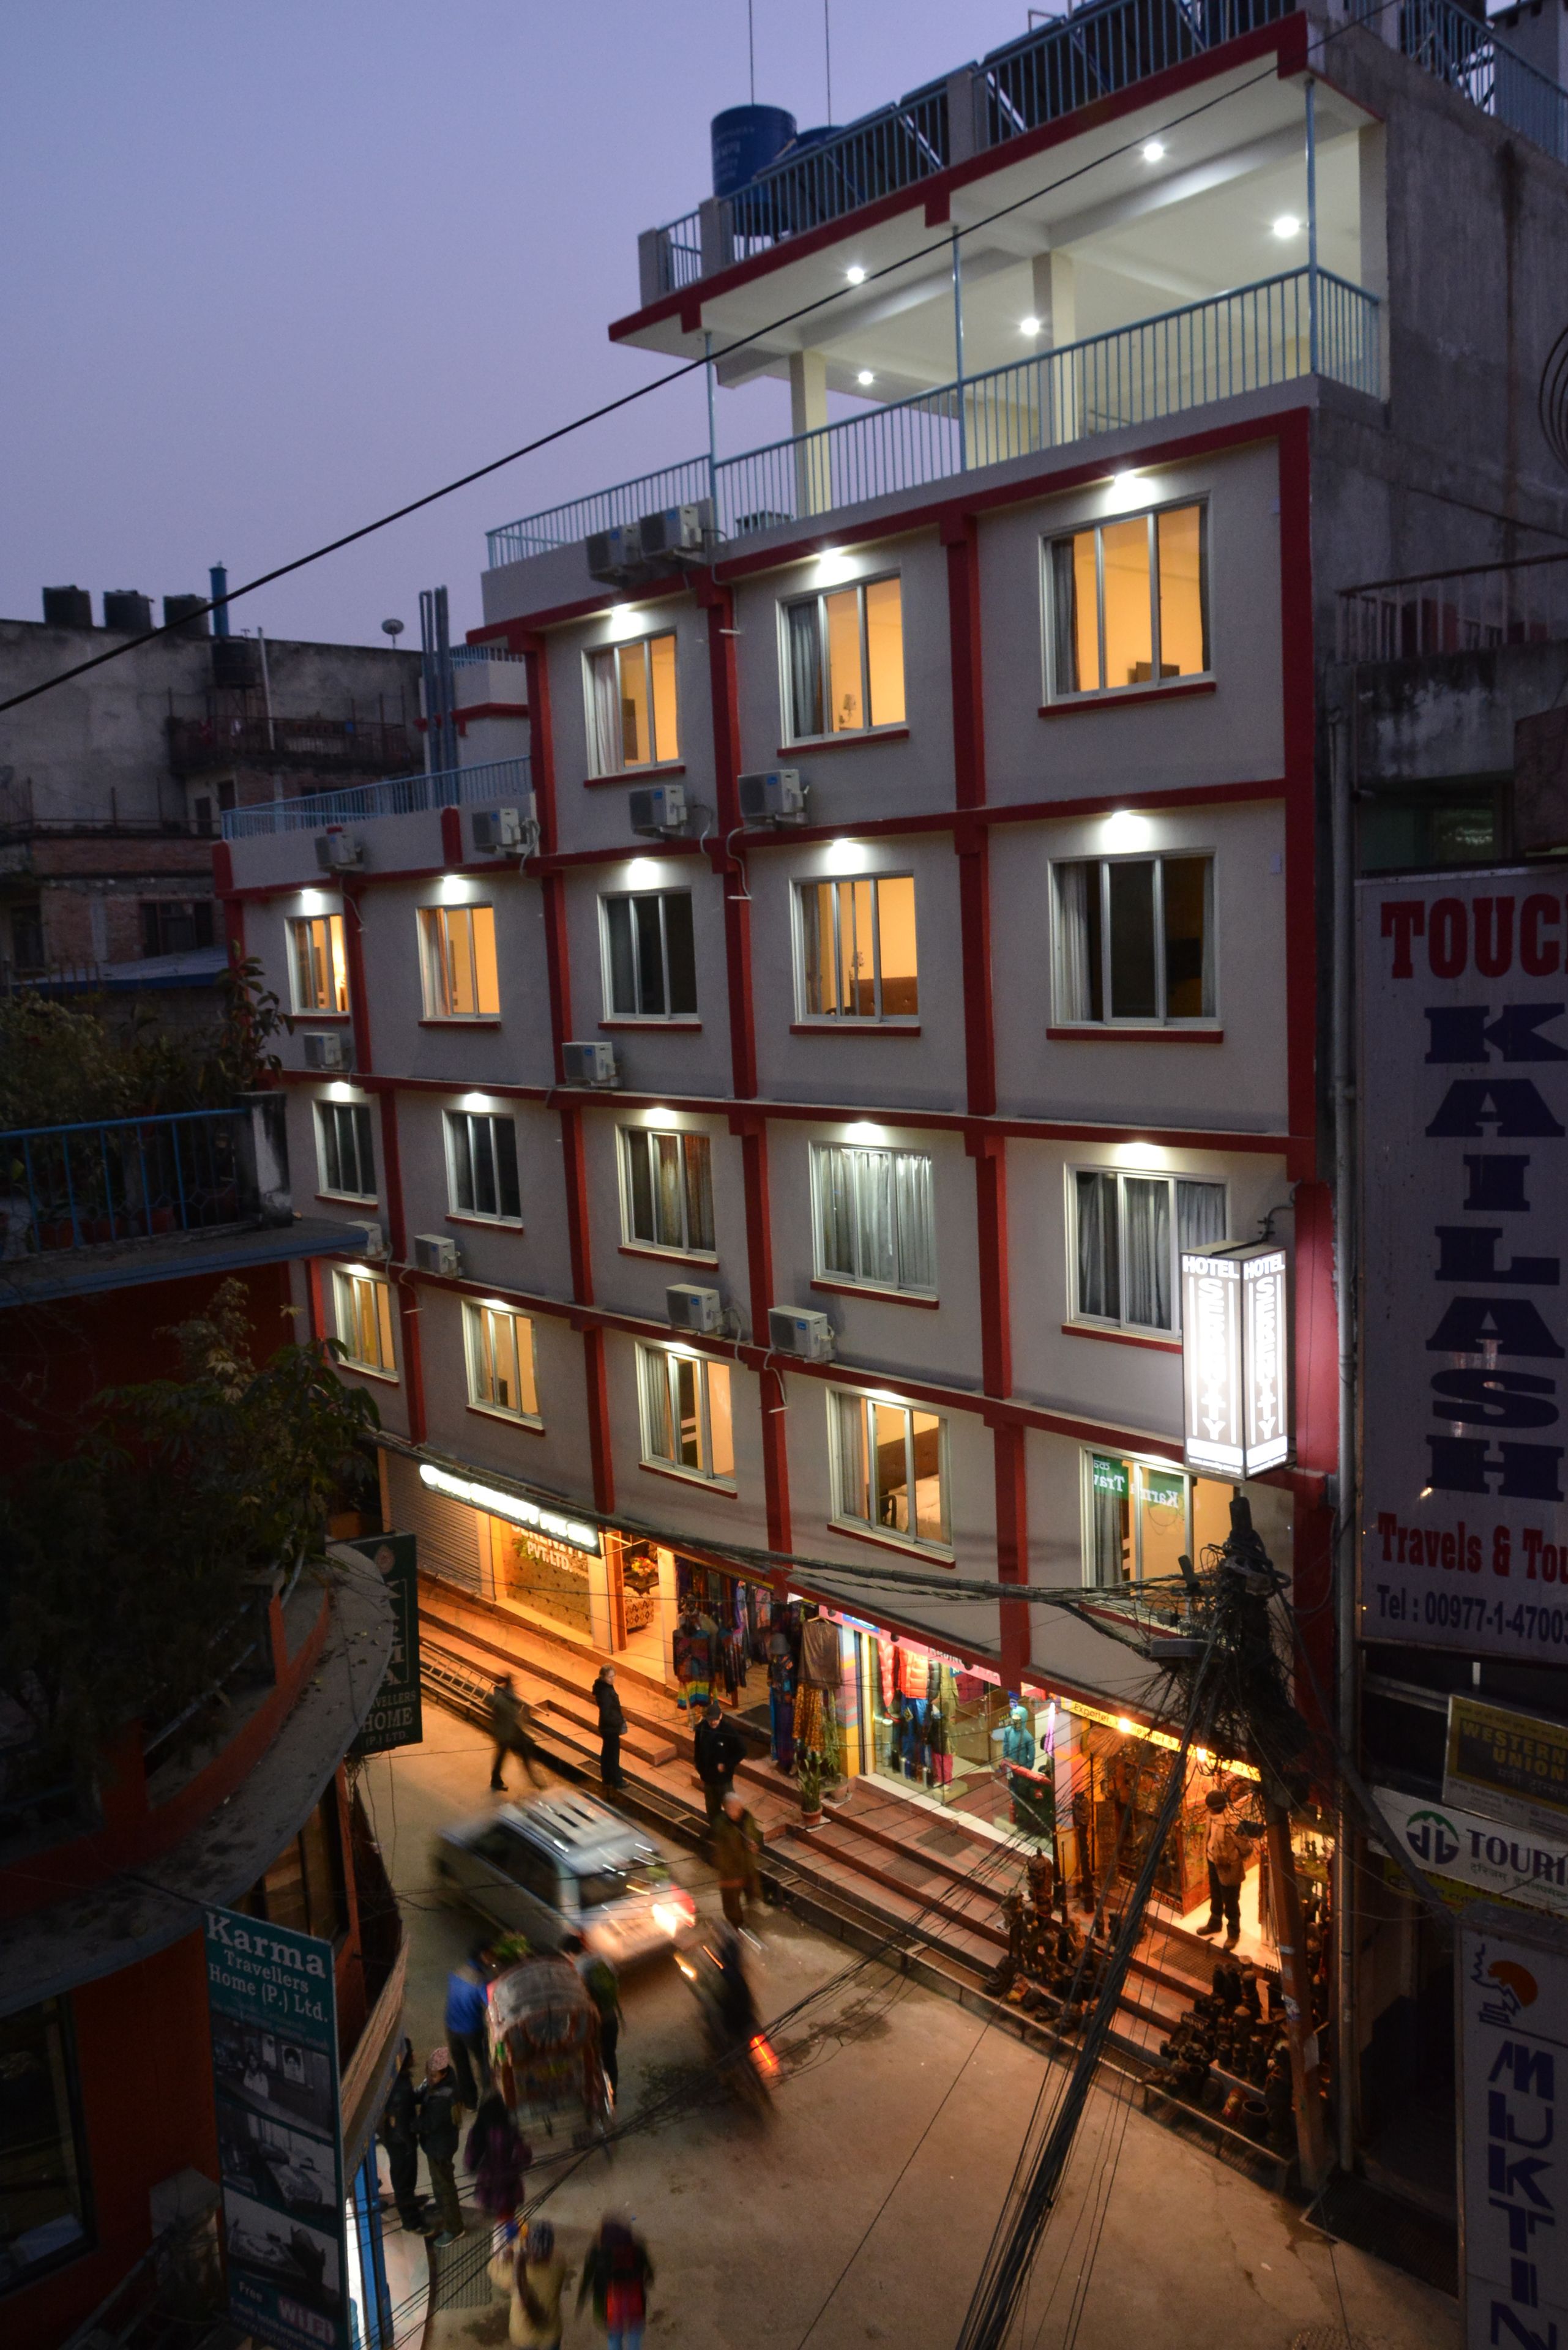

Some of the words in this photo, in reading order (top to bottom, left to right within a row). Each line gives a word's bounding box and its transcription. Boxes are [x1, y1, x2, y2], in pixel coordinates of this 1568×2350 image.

[1381, 892, 1568, 979] TOUC
[1182, 1255, 1240, 1279] HOTEL
[1244, 1253, 1285, 1280] HOTEL
[1423, 1002, 1567, 1502] KAILASH
[1378, 1512, 1483, 1574] Travels
[1491, 1524, 1511, 1577] &
[1376, 1584, 1407, 1621] Tel
[361, 1706, 413, 1734] HOME
[371, 1690, 417, 1709] VELLERS
[1460, 1718, 1568, 1766] WESTERN
[1492, 1747, 1568, 1783] UNION
[1466, 1829, 1568, 1887] TOURI
[205, 1911, 327, 1979] Karma
[208, 1963, 256, 1996] Home
[261, 1982, 288, 2013] (P.)
[293, 1993, 329, 2023] Ltd.
[223, 1949, 310, 1994] Travellers
